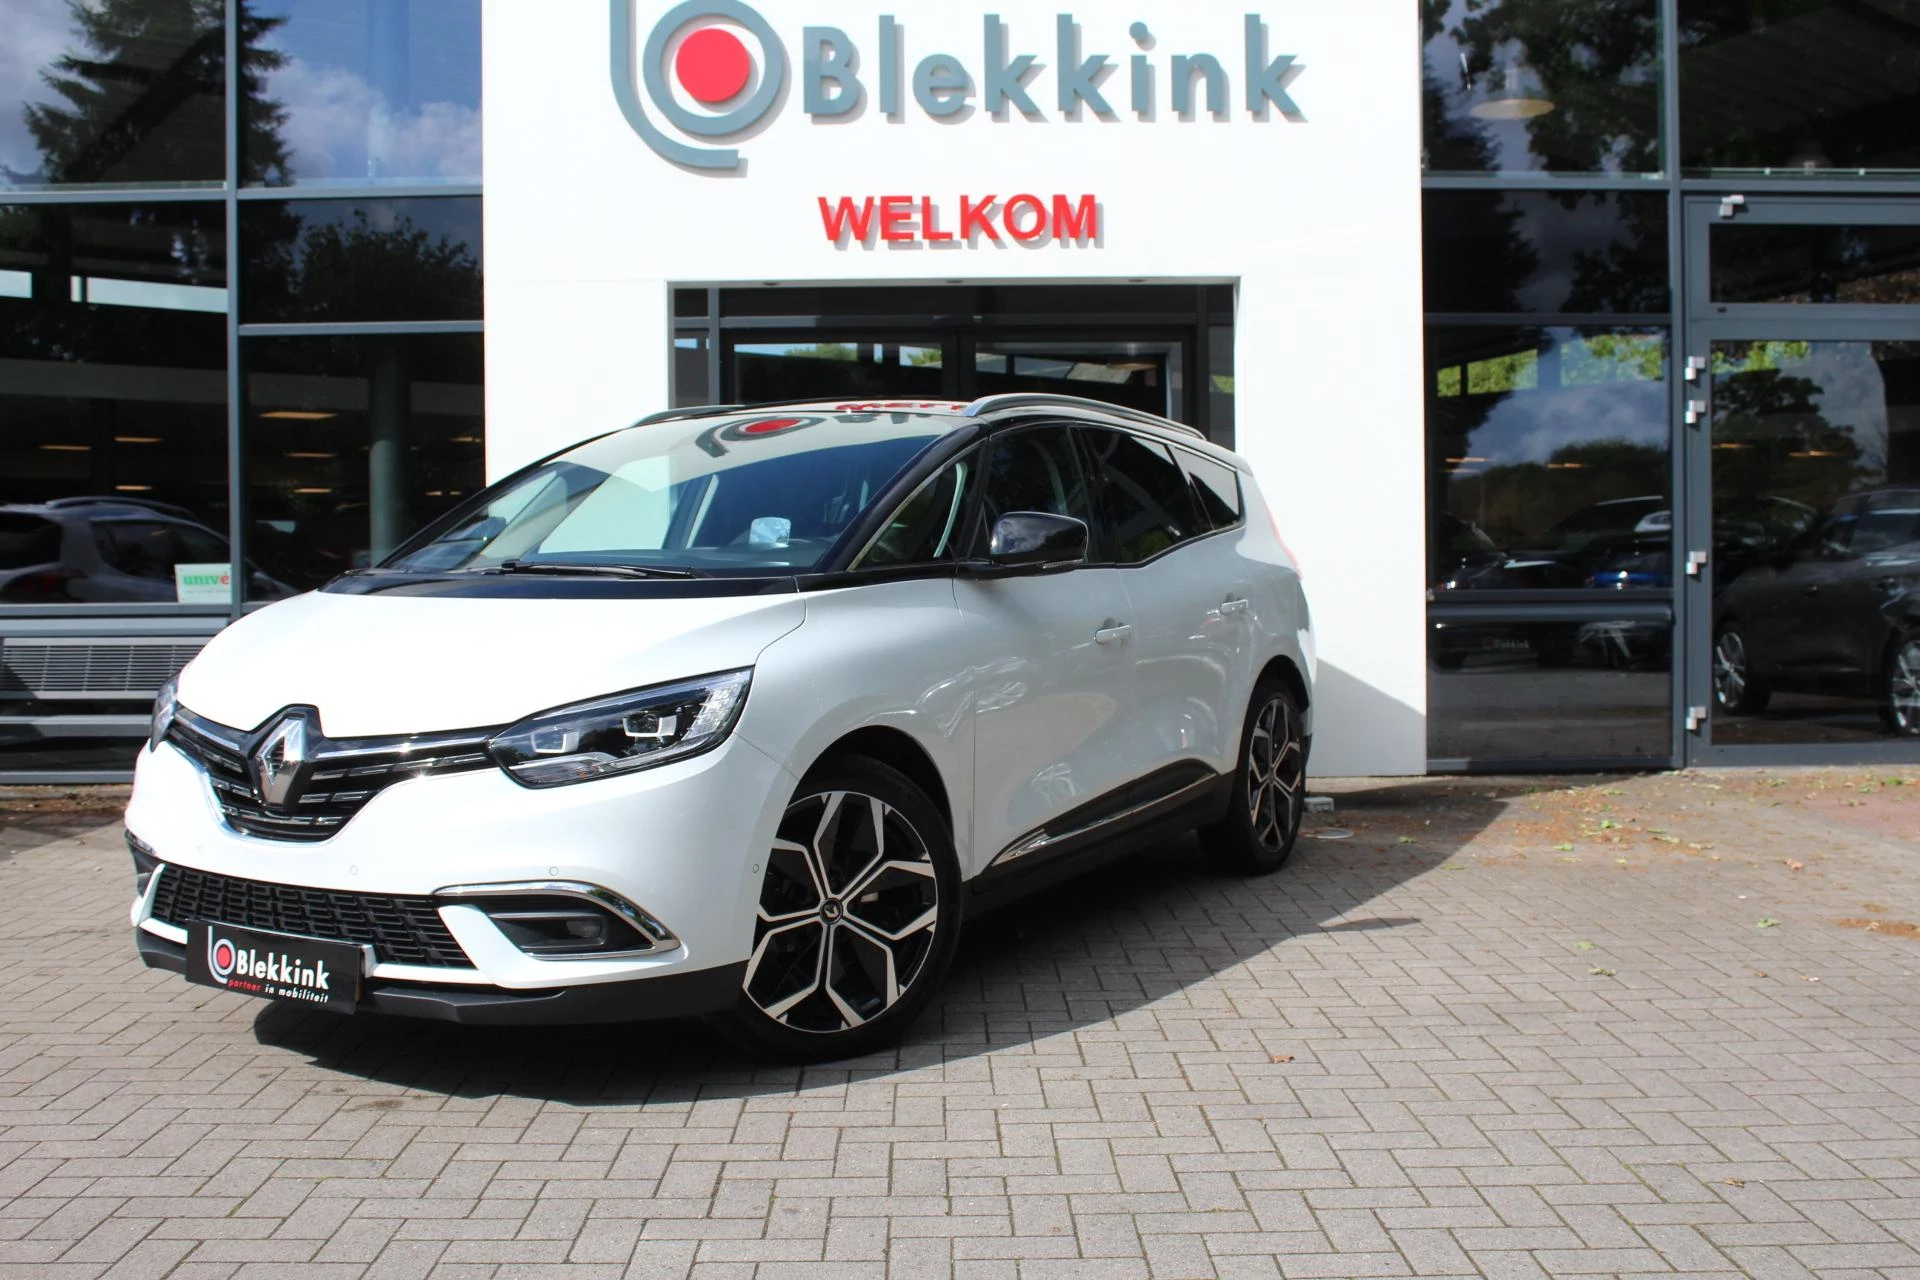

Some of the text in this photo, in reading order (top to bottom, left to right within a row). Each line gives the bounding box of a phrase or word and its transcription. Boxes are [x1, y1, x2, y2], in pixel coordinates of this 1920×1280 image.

[803, 13, 1301, 114] Blekkink
[818, 194, 1098, 242] WELKOM
[228, 979, 329, 1003] partner in mobiliteit
[236, 949, 330, 990] Blekkink
